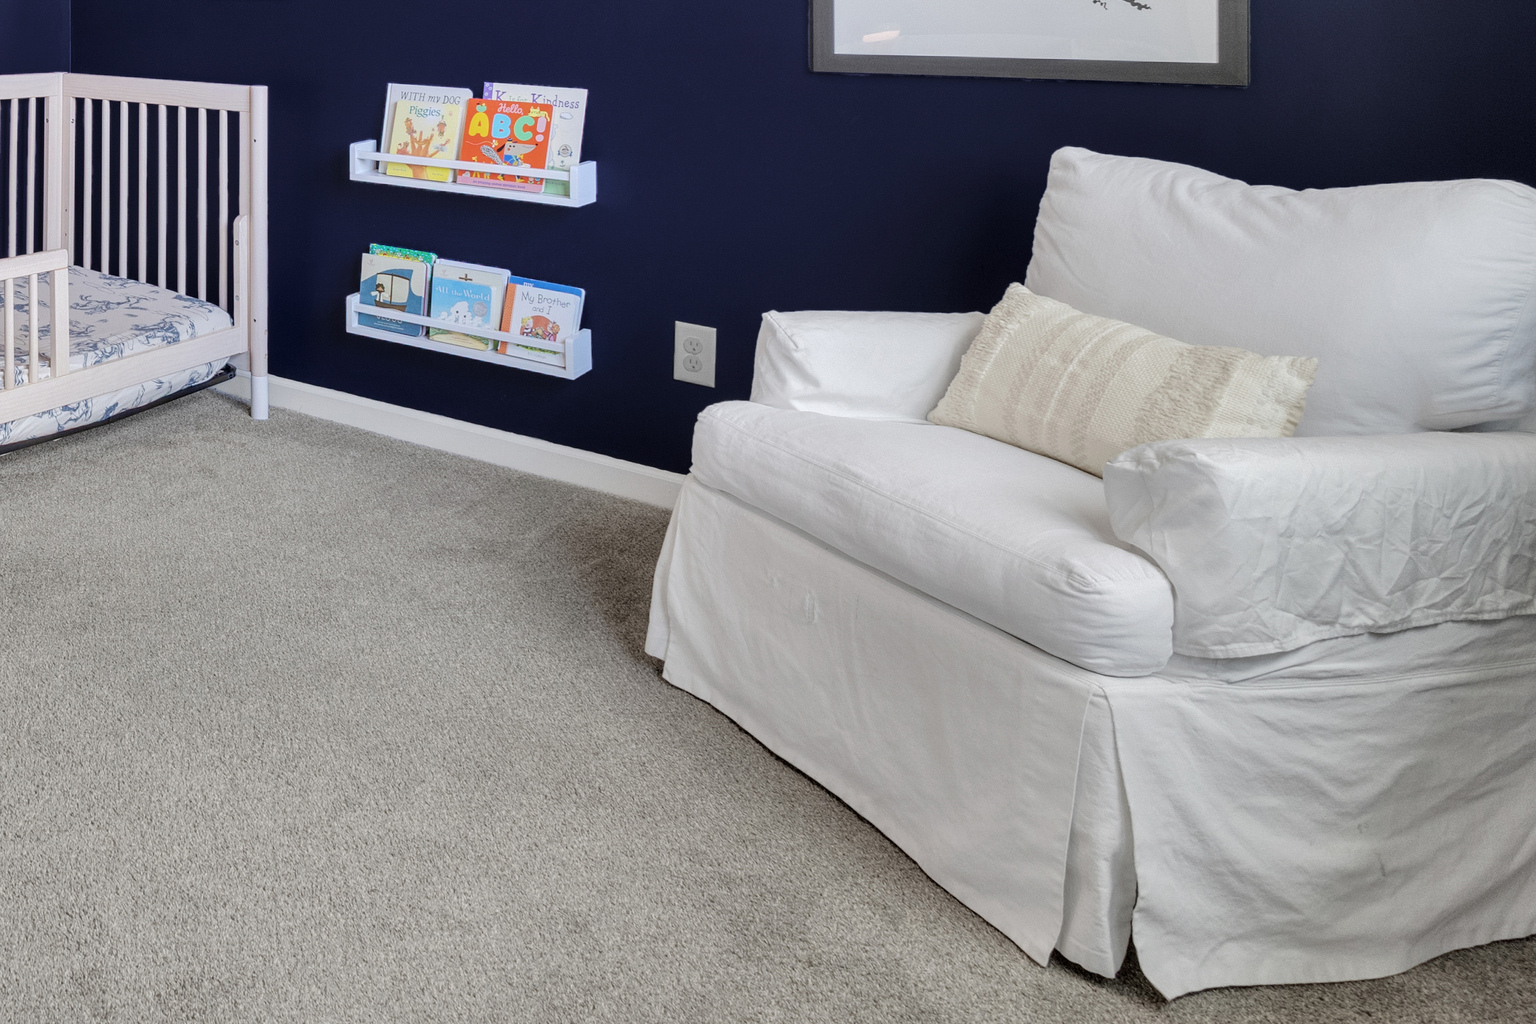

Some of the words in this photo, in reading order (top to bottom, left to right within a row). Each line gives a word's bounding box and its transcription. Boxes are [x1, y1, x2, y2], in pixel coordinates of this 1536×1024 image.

[400, 91, 426, 102] WITH
[427, 95, 441, 104] my
[442, 95, 461, 106] DOG
[495, 89, 507, 102] K
[531, 93, 580, 110] Kindness
[409, 105, 441, 118] Piggies
[497, 103, 524, 116] Hello,
[468, 112, 547, 142] ABC!
[436, 284, 449, 295] All
[451, 289, 463, 297] the
[463, 289, 491, 302] World
[521, 291, 535, 304] My
[537, 293, 571, 308] Brother
[532, 305, 544, 313] and
[546, 305, 552, 315] I
